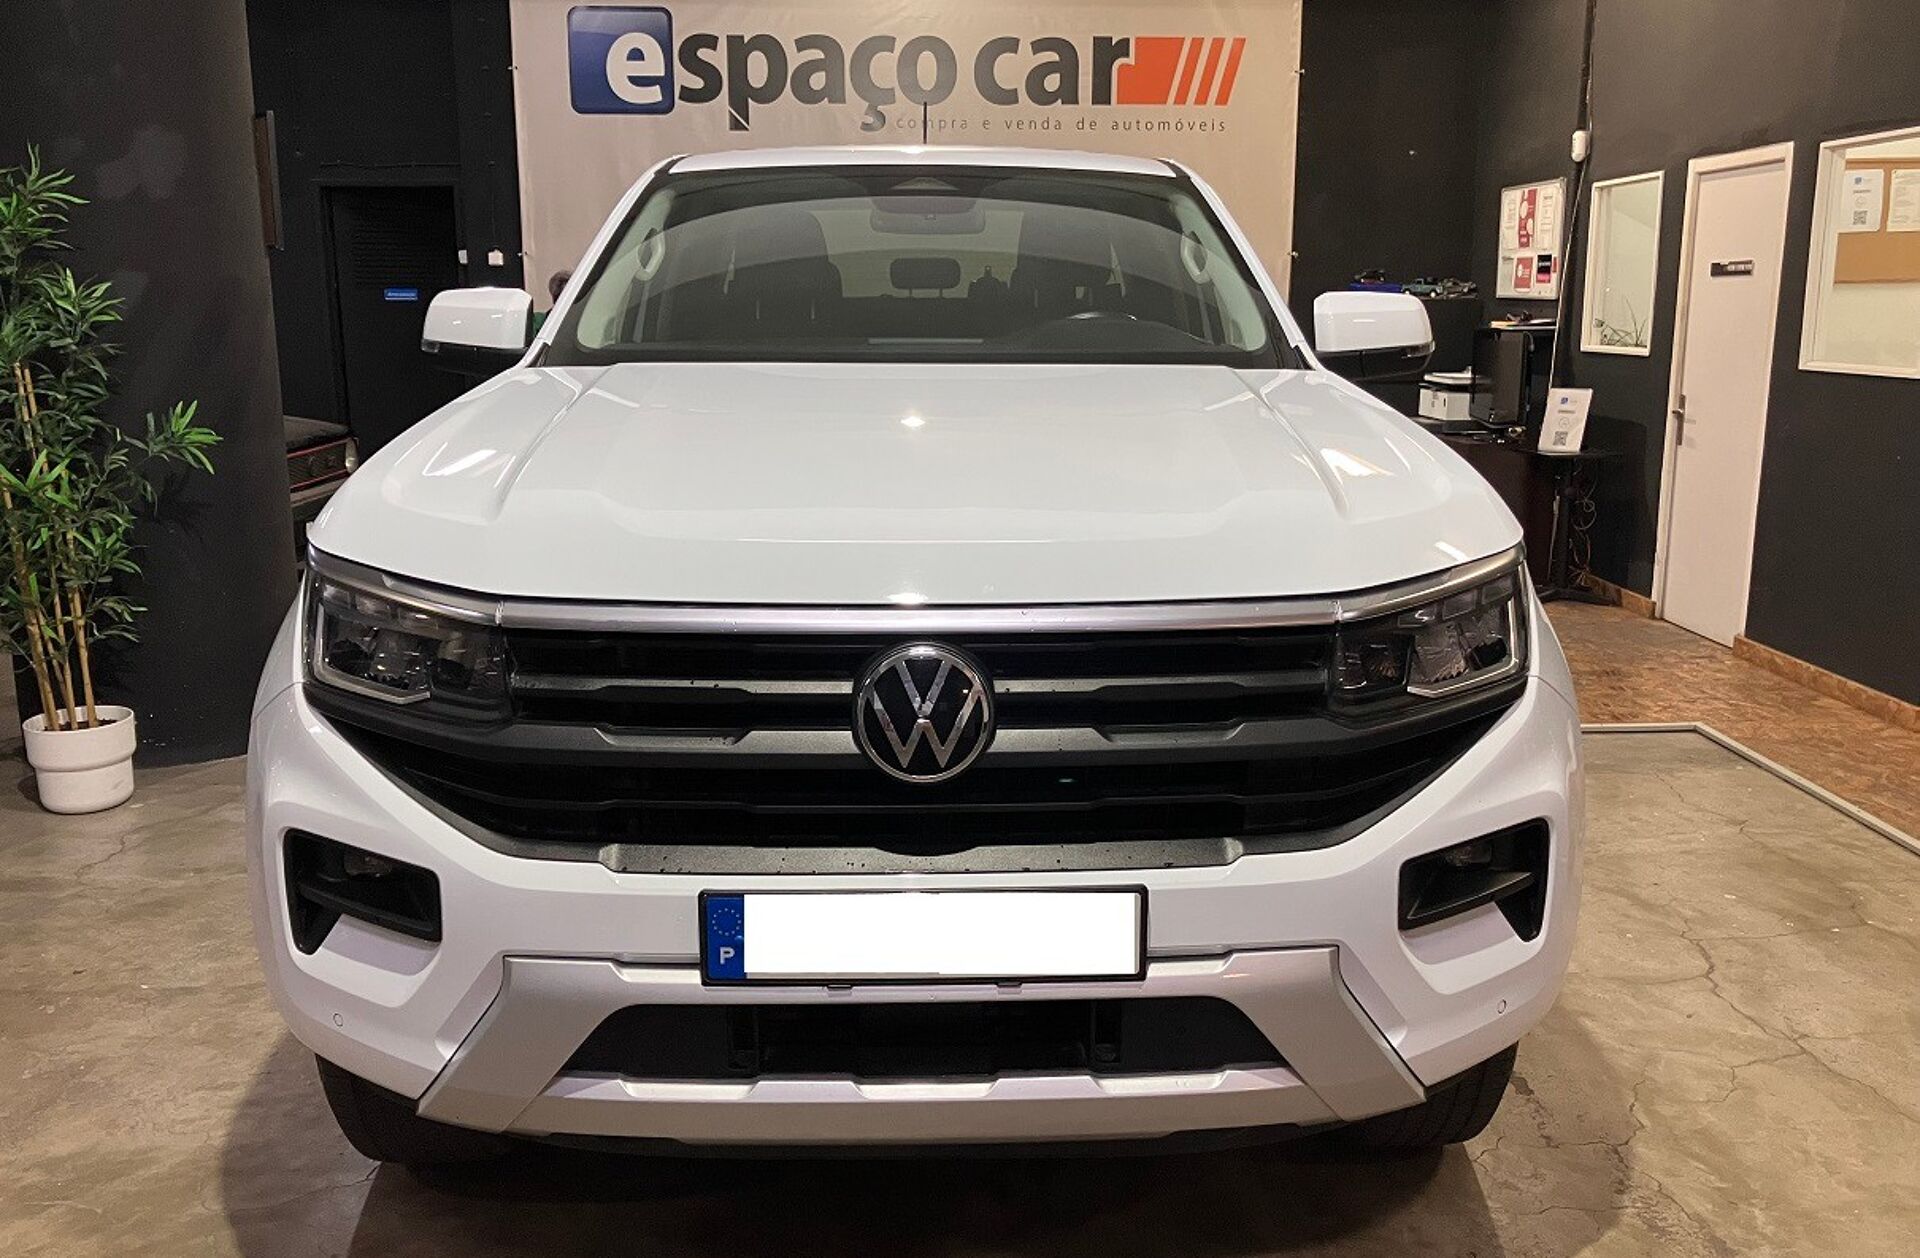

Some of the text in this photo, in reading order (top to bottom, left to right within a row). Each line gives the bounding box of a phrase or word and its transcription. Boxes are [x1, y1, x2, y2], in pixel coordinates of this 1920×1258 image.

[604, 32, 1131, 132] espaço car
[982, 119, 991, 130] e
[1004, 117, 1062, 131] venda
[1075, 117, 1097, 131] de
[1111, 118, 1226, 132] automóveis
[718, 946, 736, 965] P
